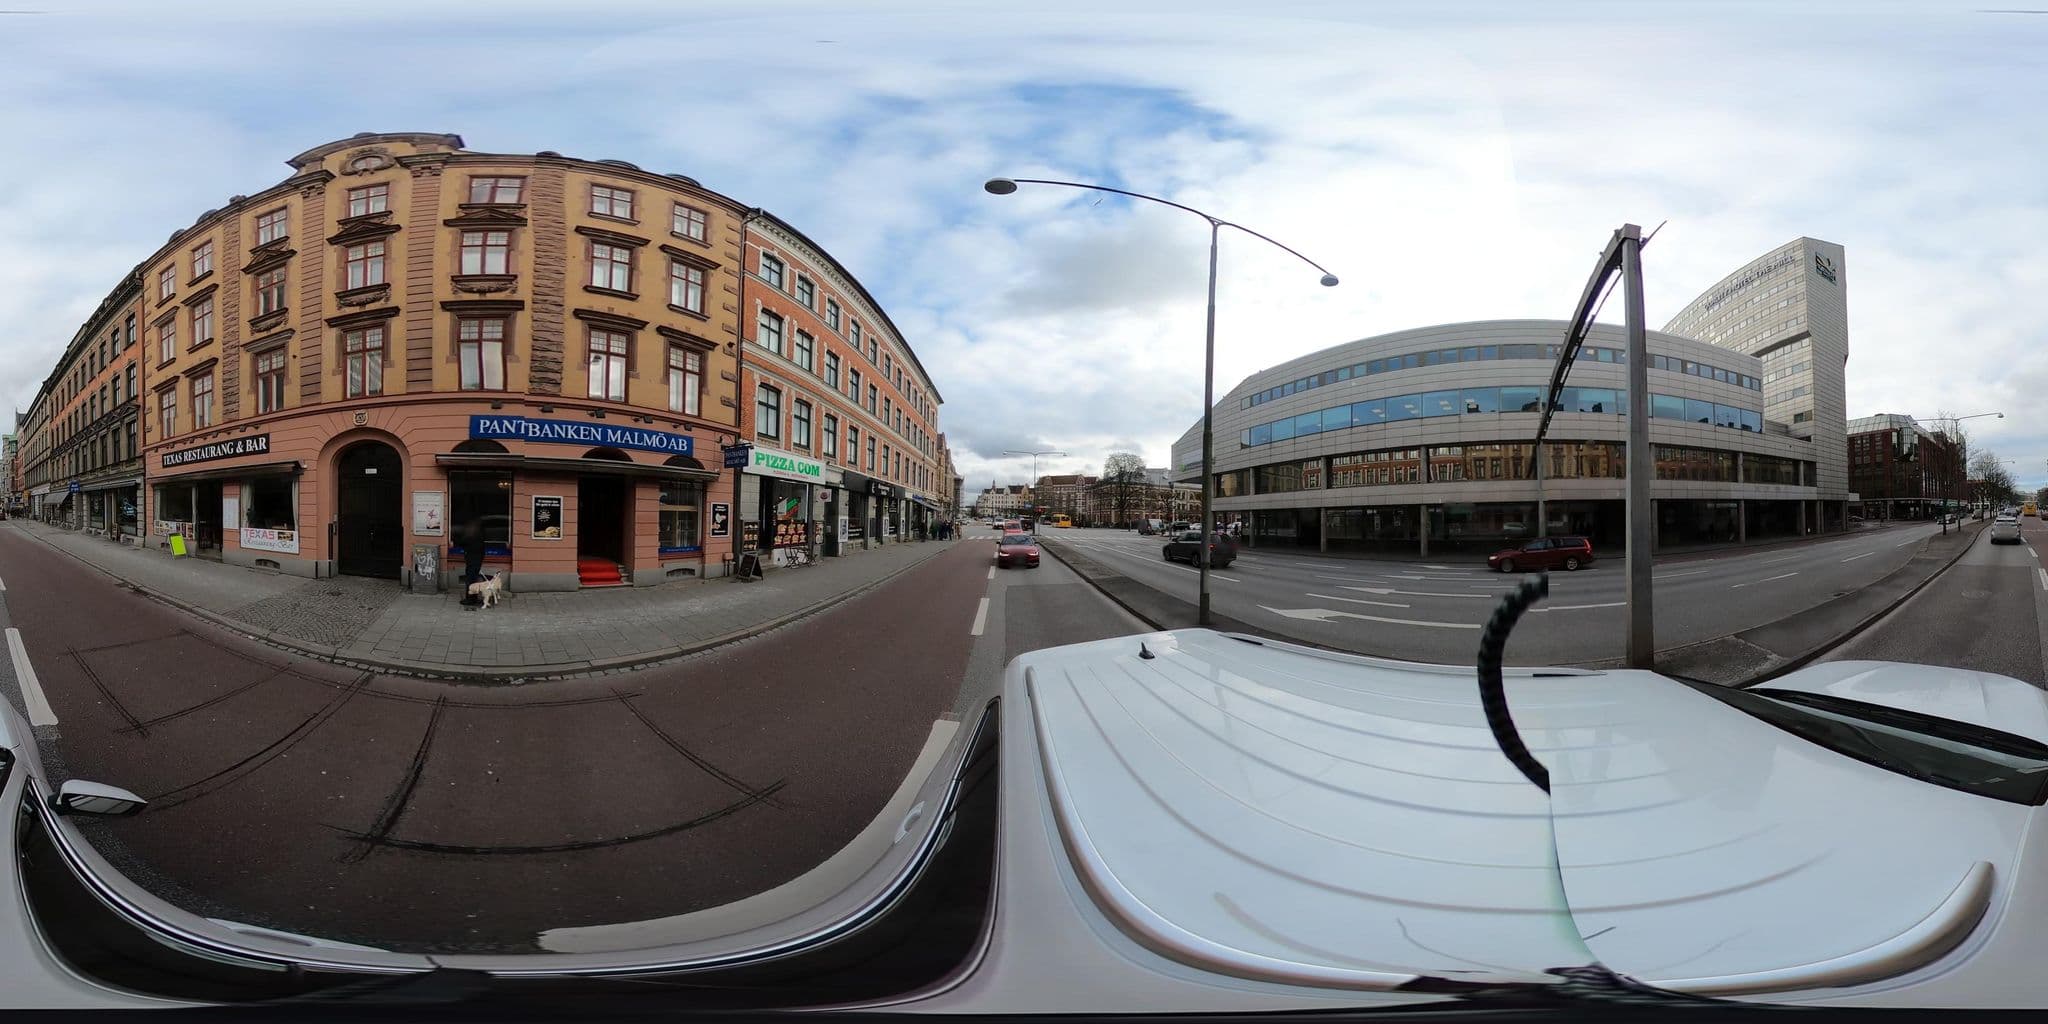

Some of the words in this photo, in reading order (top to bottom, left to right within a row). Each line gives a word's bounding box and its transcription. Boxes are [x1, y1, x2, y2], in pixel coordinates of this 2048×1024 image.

[479, 419, 602, 441] PANTBANKEN
[606, 429, 667, 449] MALMÖ
[668, 437, 688, 451] AB
[163, 454, 183, 466] TEXAS
[183, 441, 234, 462] RESTAURANG
[235, 440, 245, 453] &
[245, 437, 268, 452] BAR
[754, 452, 796, 472] PIZZA
[797, 461, 821, 477] COM
[244, 528, 275, 540] TEXAS
